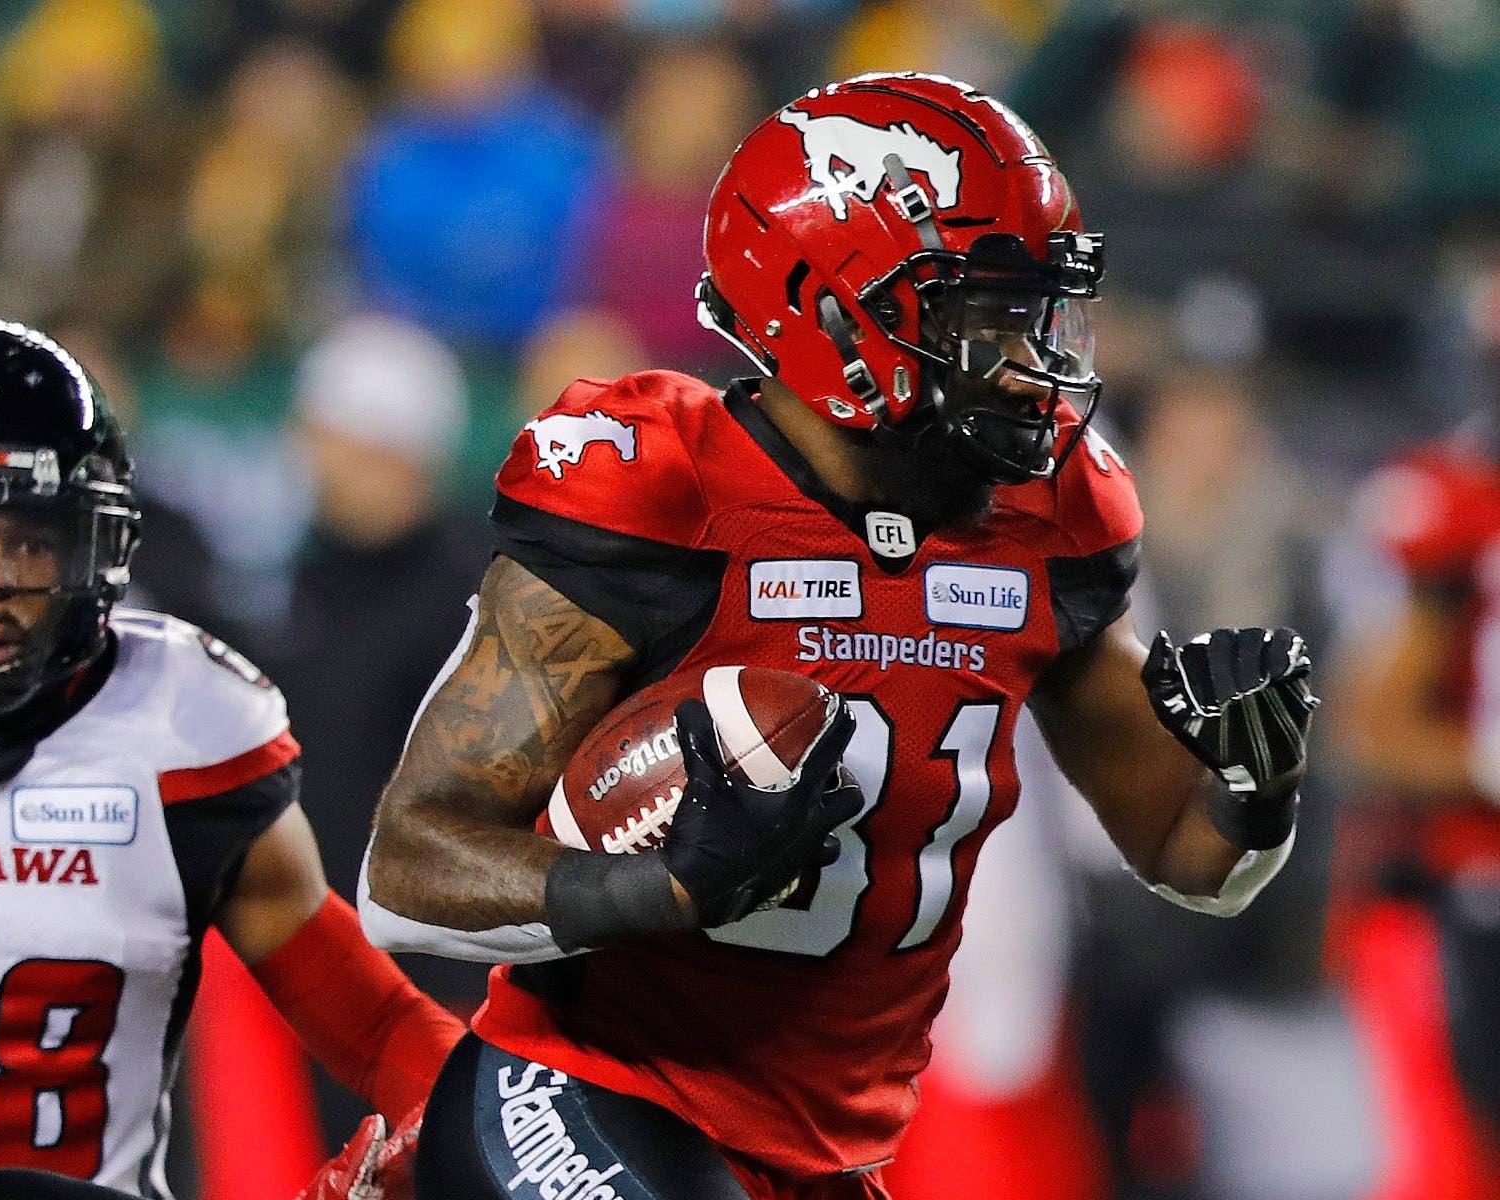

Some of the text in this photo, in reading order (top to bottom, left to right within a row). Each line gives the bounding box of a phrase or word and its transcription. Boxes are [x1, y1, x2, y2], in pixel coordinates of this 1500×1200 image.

[874, 524, 908, 546] CFL
[949, 583, 1022, 609] Sun Life
[796, 625, 986, 672] Stampeders
[587, 715, 682, 801] Wilson
[40, 801, 128, 822] Sun Life
